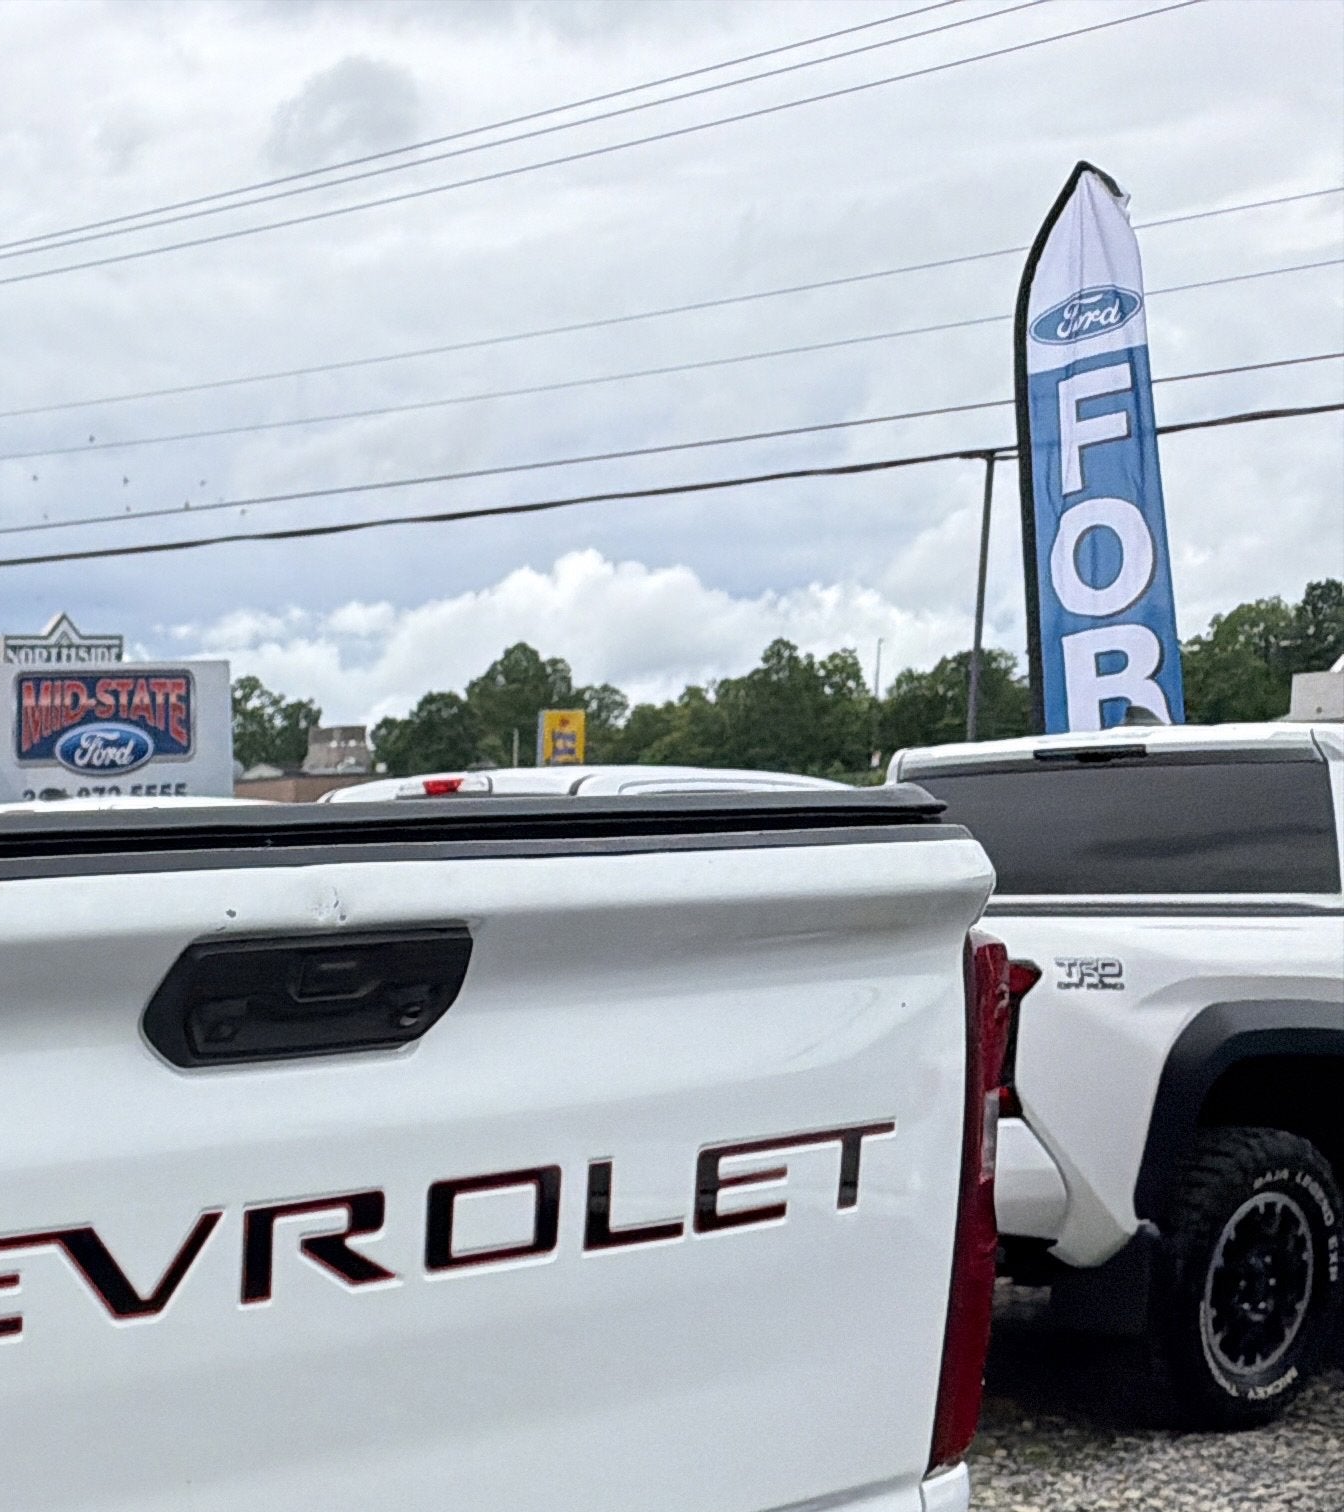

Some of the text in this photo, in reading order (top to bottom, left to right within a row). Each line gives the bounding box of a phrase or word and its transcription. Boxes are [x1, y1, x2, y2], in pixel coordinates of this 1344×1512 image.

[1055, 293, 1122, 339] Ford
[6, 646, 122, 664] NORTHSIDE
[20, 676, 189, 753] MID-STATE
[73, 731, 136, 768] Ford
[1054, 957, 1123, 986] TRD
